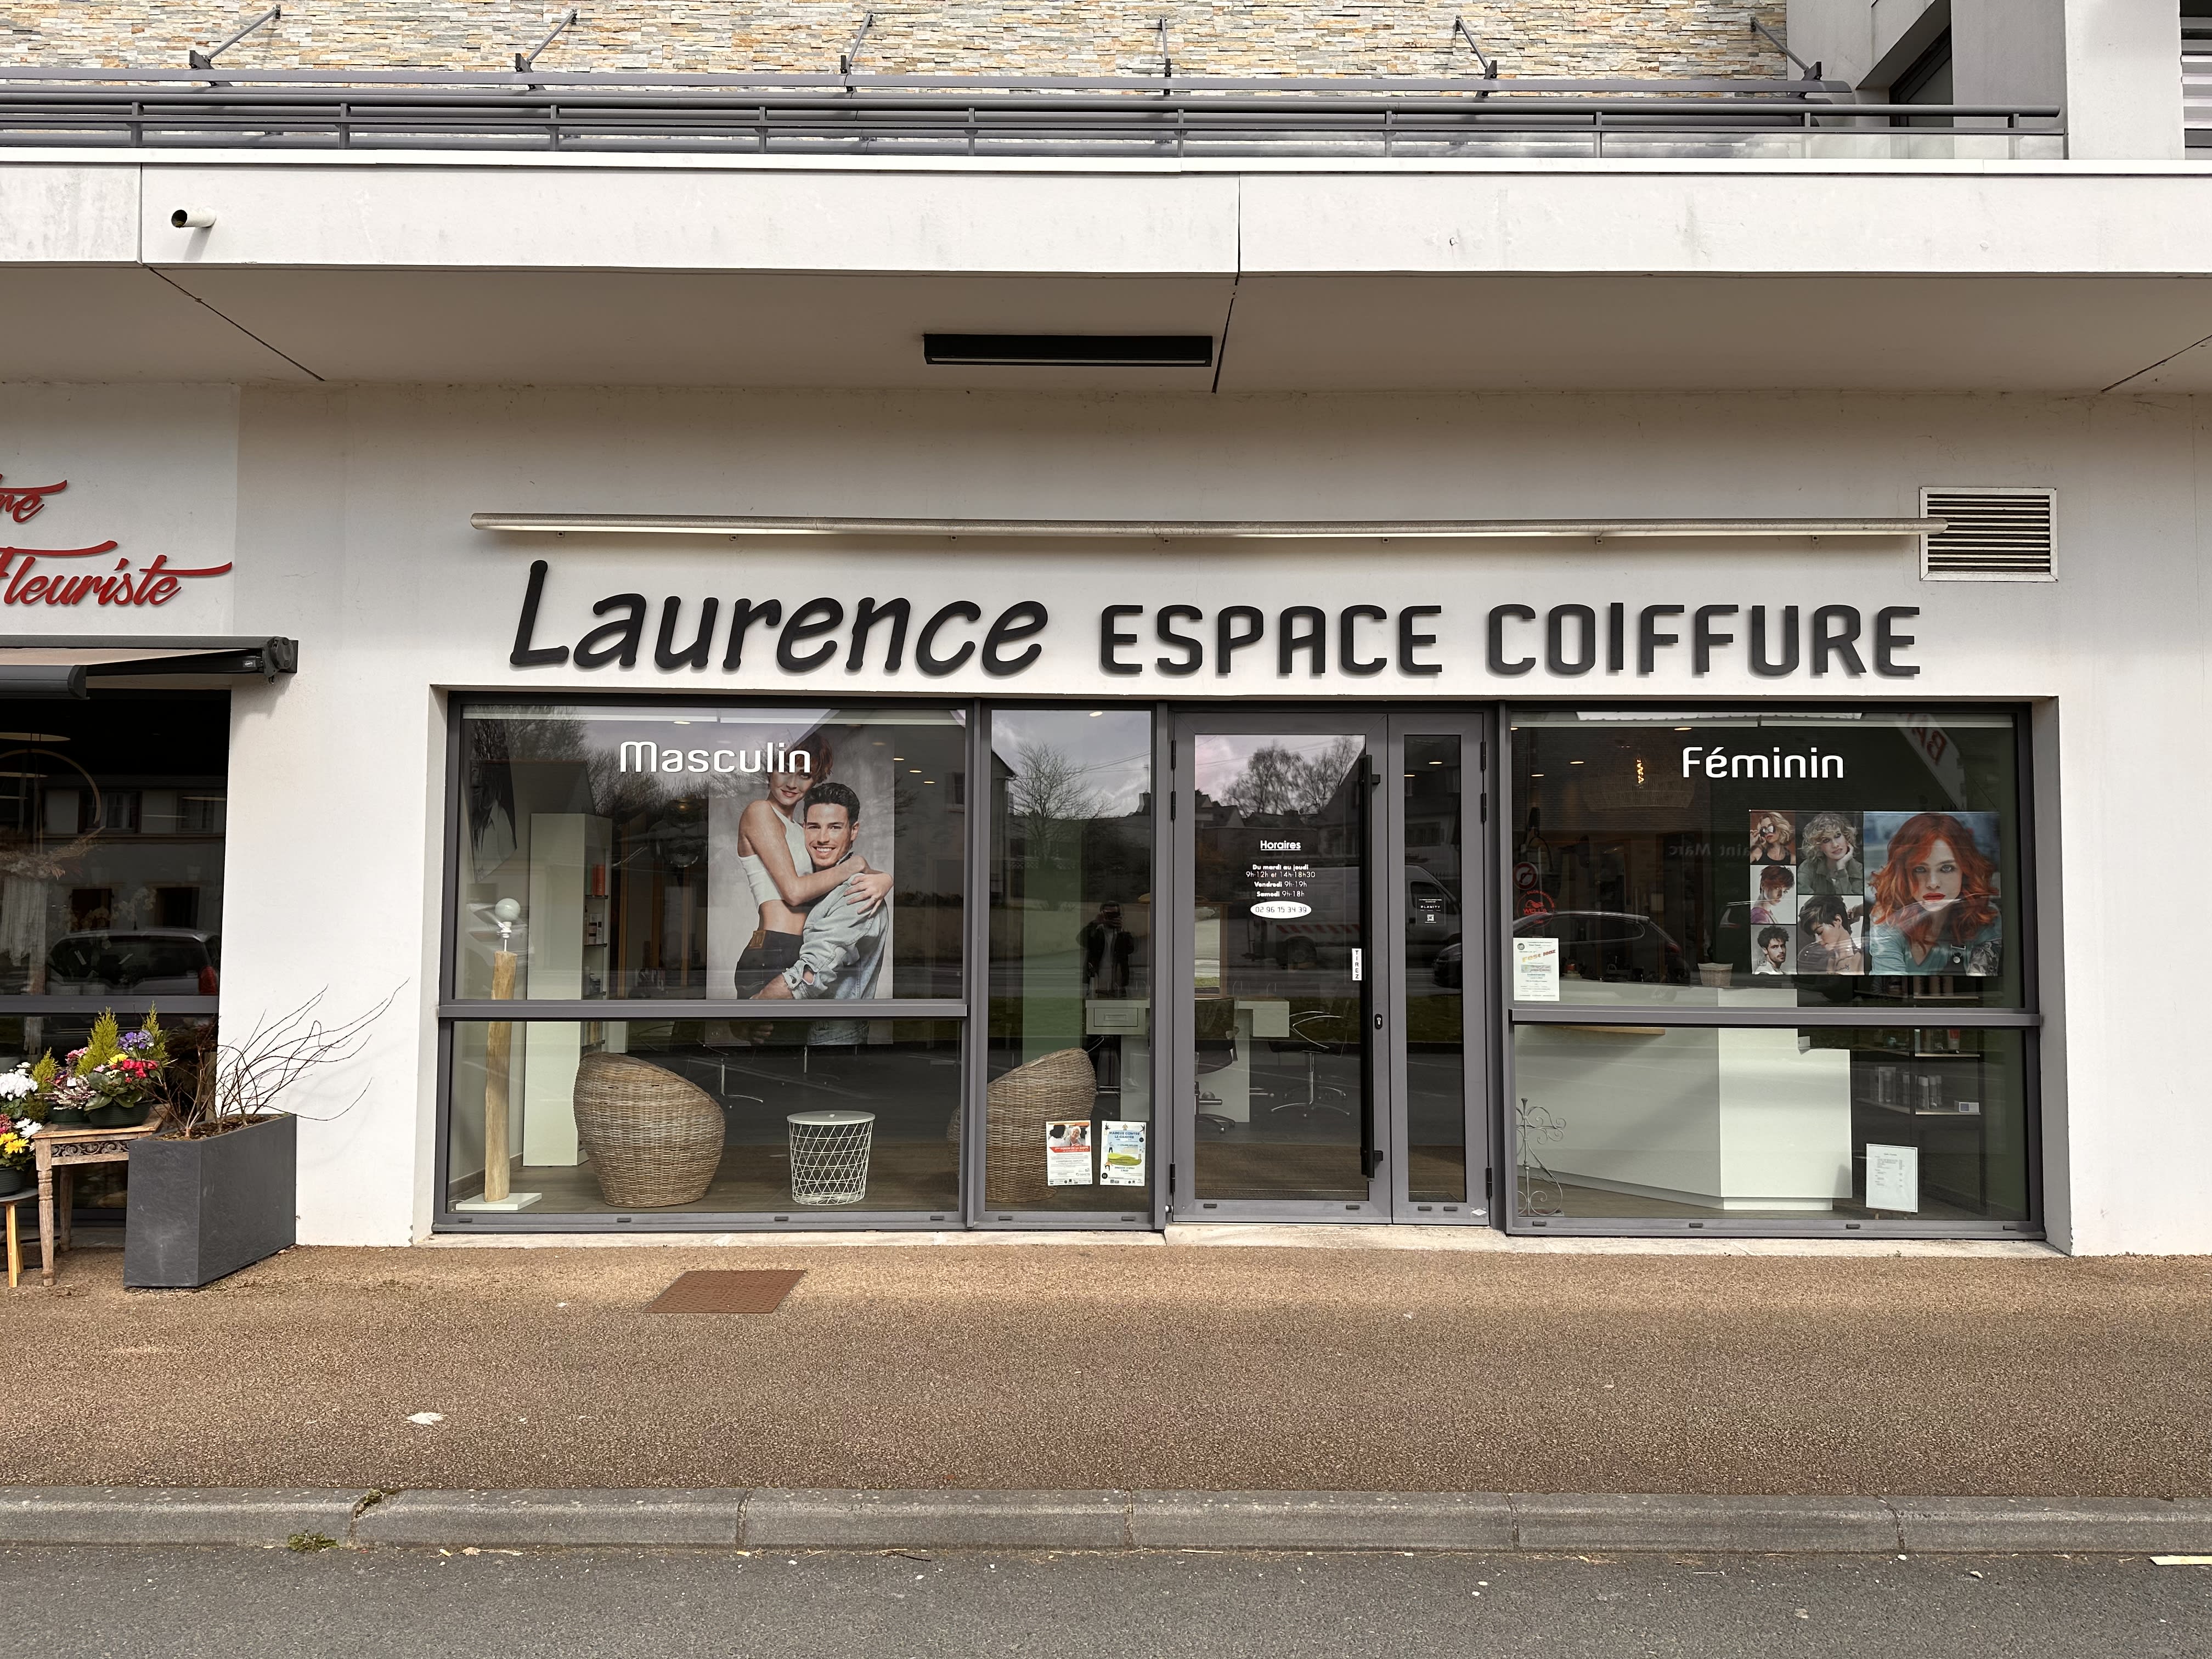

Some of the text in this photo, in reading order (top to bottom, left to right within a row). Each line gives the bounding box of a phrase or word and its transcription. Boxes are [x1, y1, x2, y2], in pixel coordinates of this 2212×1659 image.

[510, 560, 1921, 676] Laurence ESPACE COIFFURE
[620, 741, 811, 774] Masculin
[1683, 746, 1844, 778] Féminin
[1260, 840, 1301, 851] Horaires
